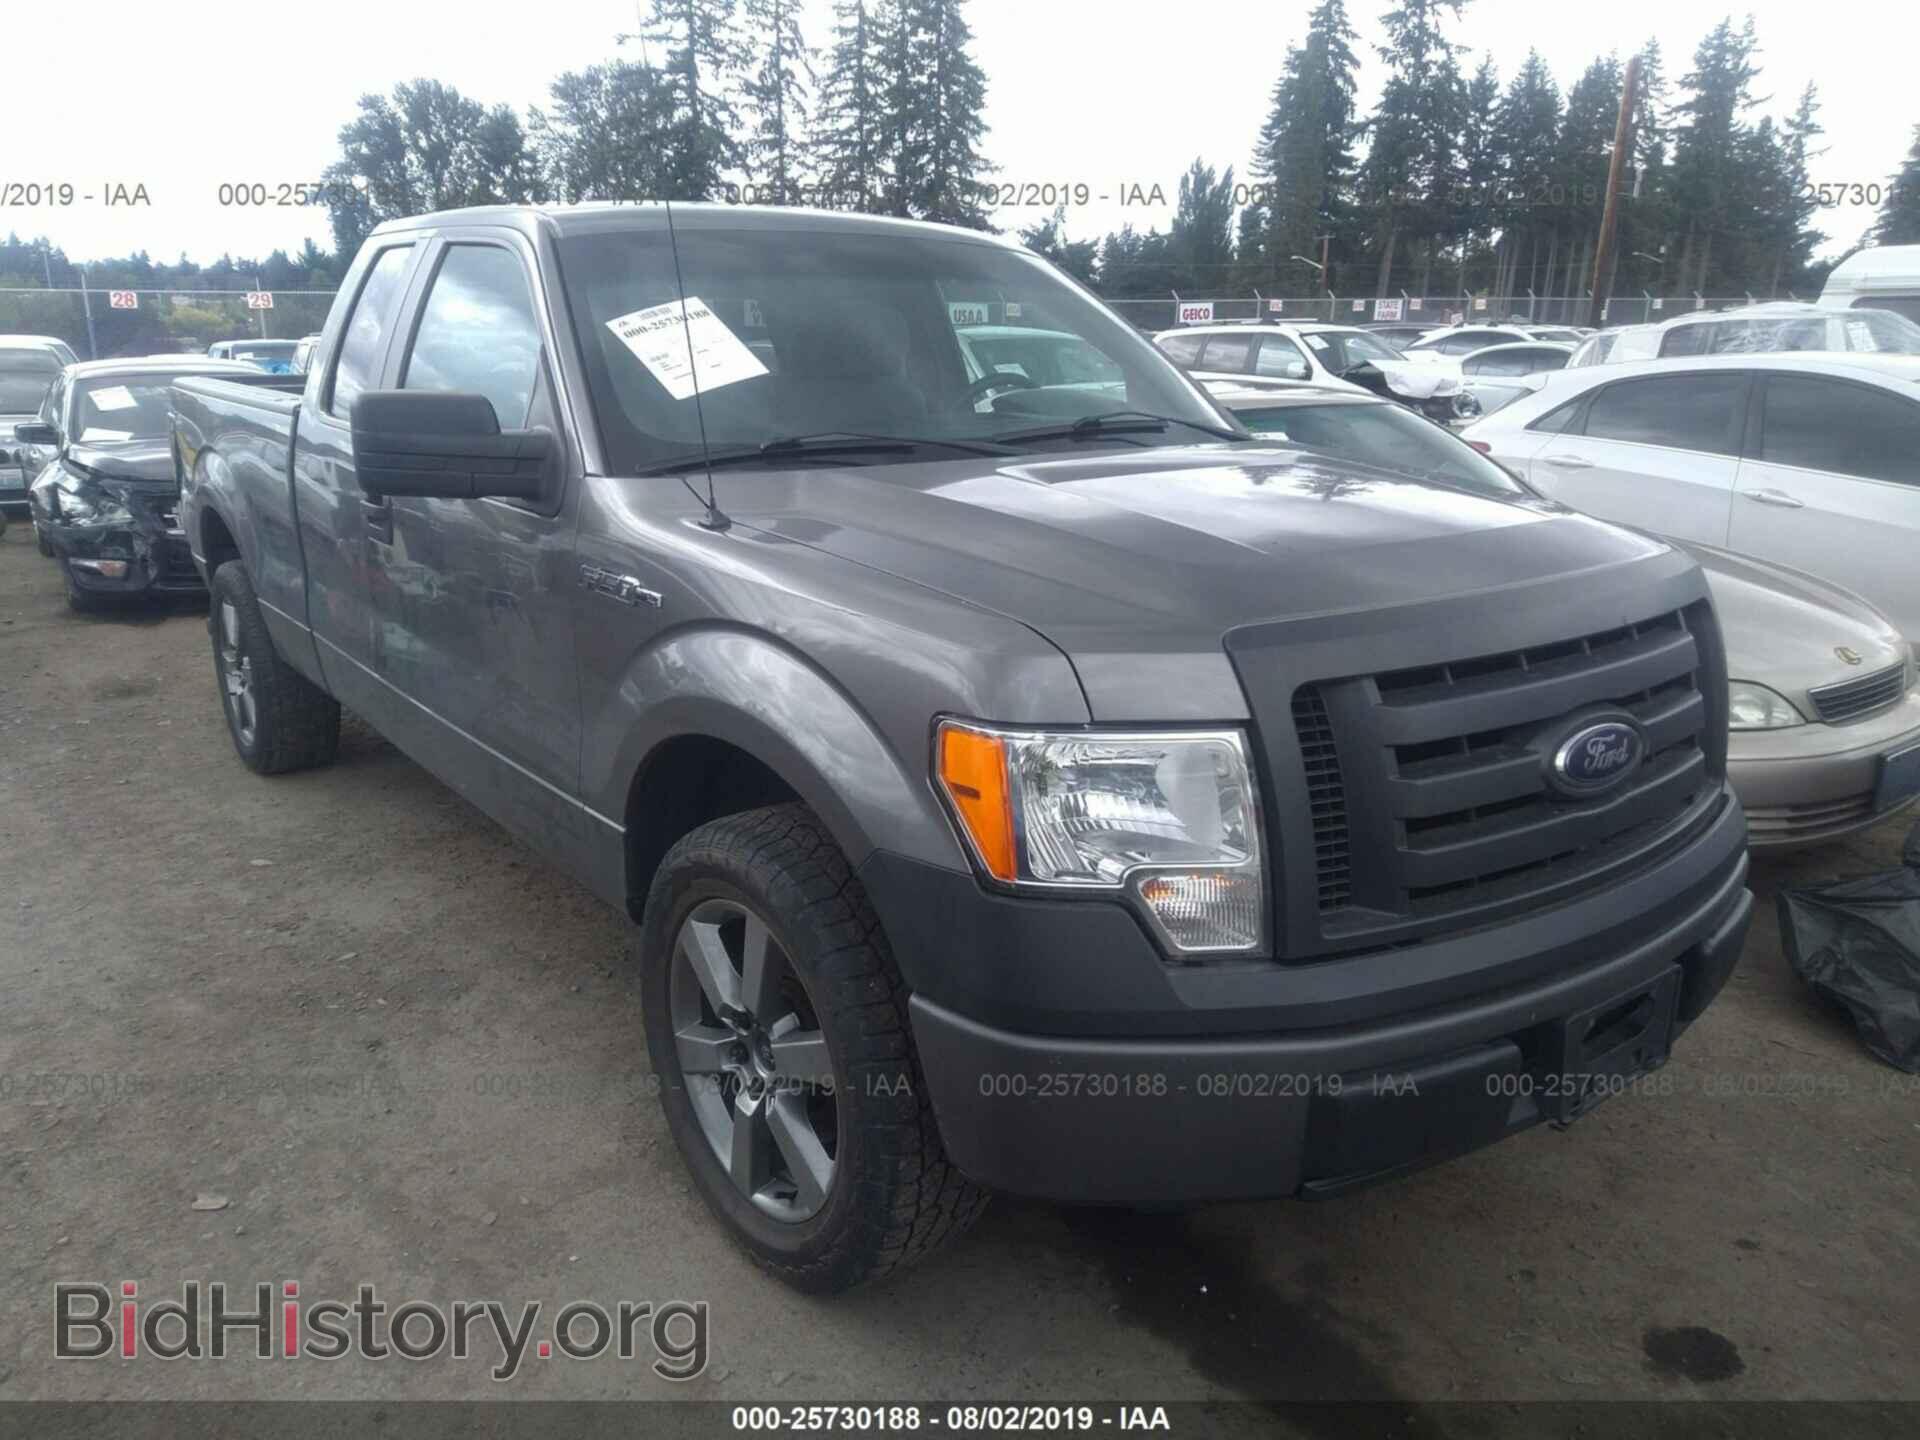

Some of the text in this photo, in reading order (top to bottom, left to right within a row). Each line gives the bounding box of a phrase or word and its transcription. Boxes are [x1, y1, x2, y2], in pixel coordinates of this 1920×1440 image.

[112, 293, 136, 308] 28
[251, 294, 271, 308] 29
[953, 309, 983, 324] USAA
[1182, 308, 1210, 321] GEICO
[1583, 733, 1630, 770] Ford
